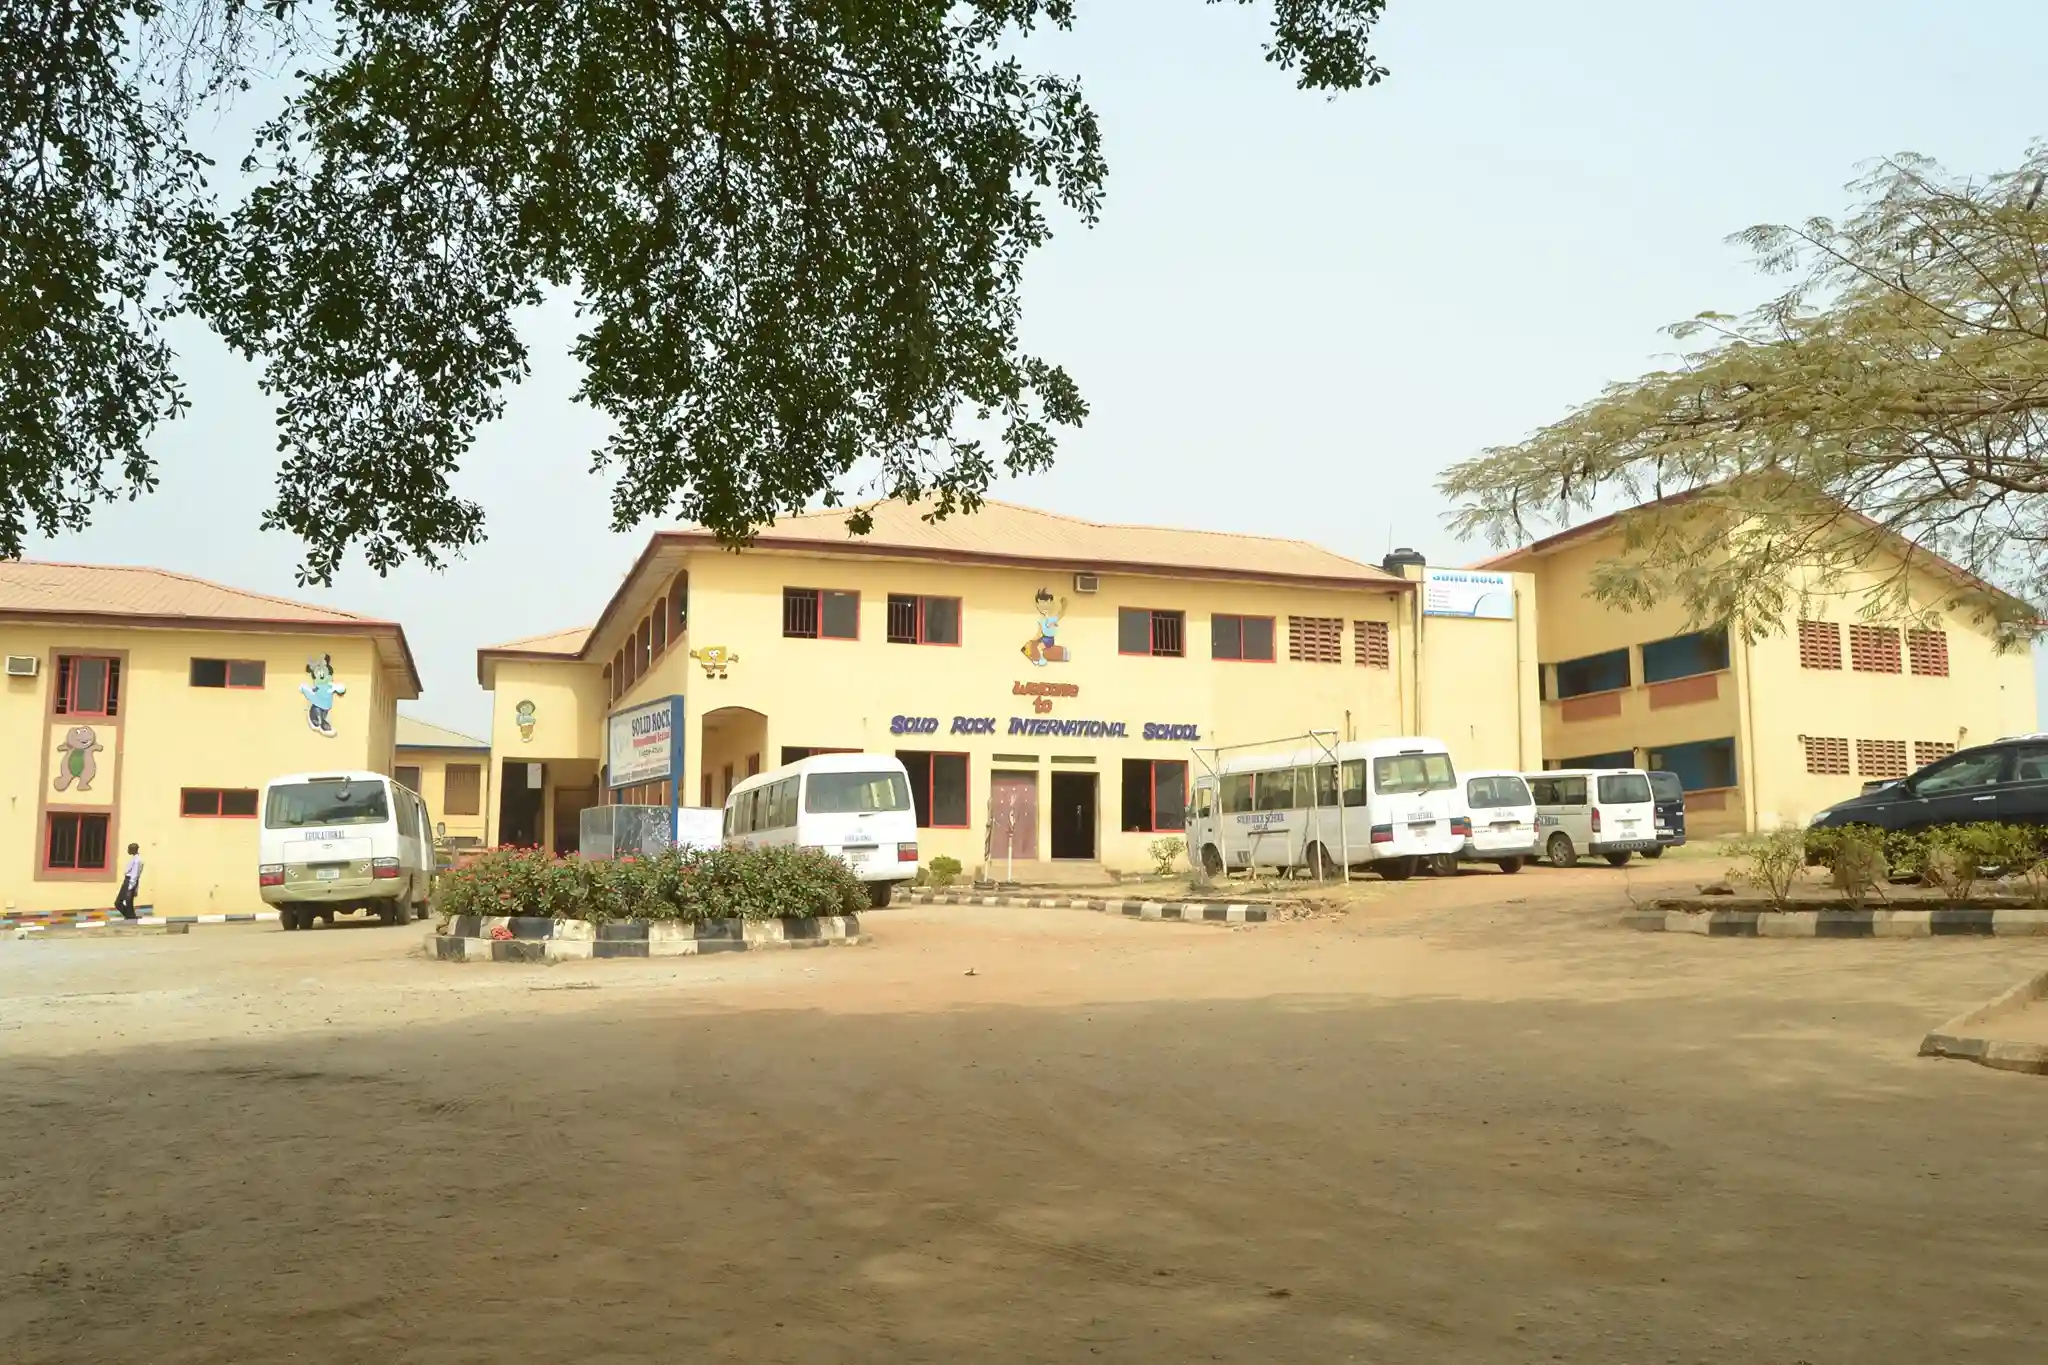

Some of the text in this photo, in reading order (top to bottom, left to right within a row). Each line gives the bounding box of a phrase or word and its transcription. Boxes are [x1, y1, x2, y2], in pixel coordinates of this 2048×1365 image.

[632, 709, 670, 737] SOLID ROCK
[890, 715, 1201, 741] SOLID ROCK INTERNATIONAL SCHOOL
